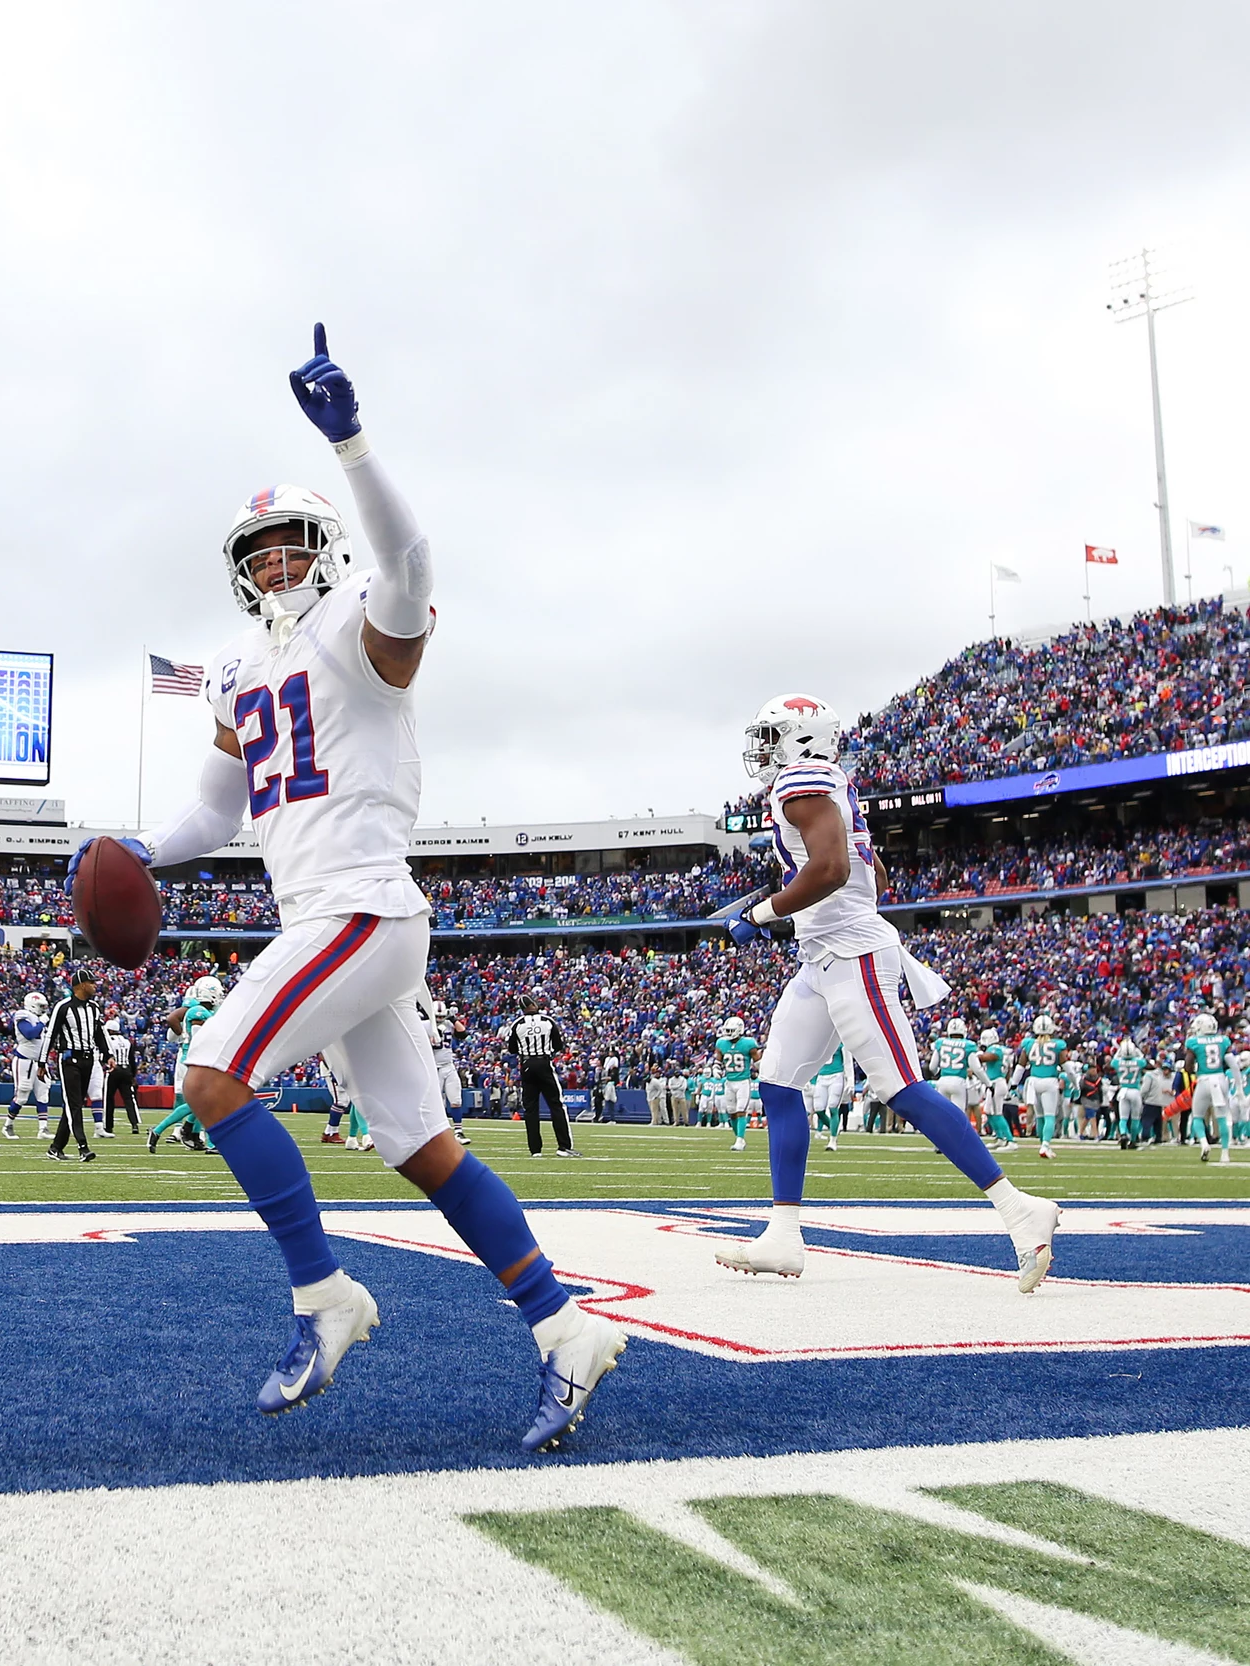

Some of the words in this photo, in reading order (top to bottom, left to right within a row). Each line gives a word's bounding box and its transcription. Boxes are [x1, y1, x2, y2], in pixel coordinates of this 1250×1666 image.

[234, 671, 329, 820] 21
[746, 816, 758, 829] 11
[549, 834, 574, 842] KELLY
[554, 876, 576, 888] 204
[526, 1026, 542, 1036] 20
[724, 1054, 744, 1072] 29
[940, 1046, 966, 1070] 52
[1029, 1042, 1056, 1066] 45
[1205, 1044, 1220, 1068] 8
[1119, 1066, 1140, 1084] 27
